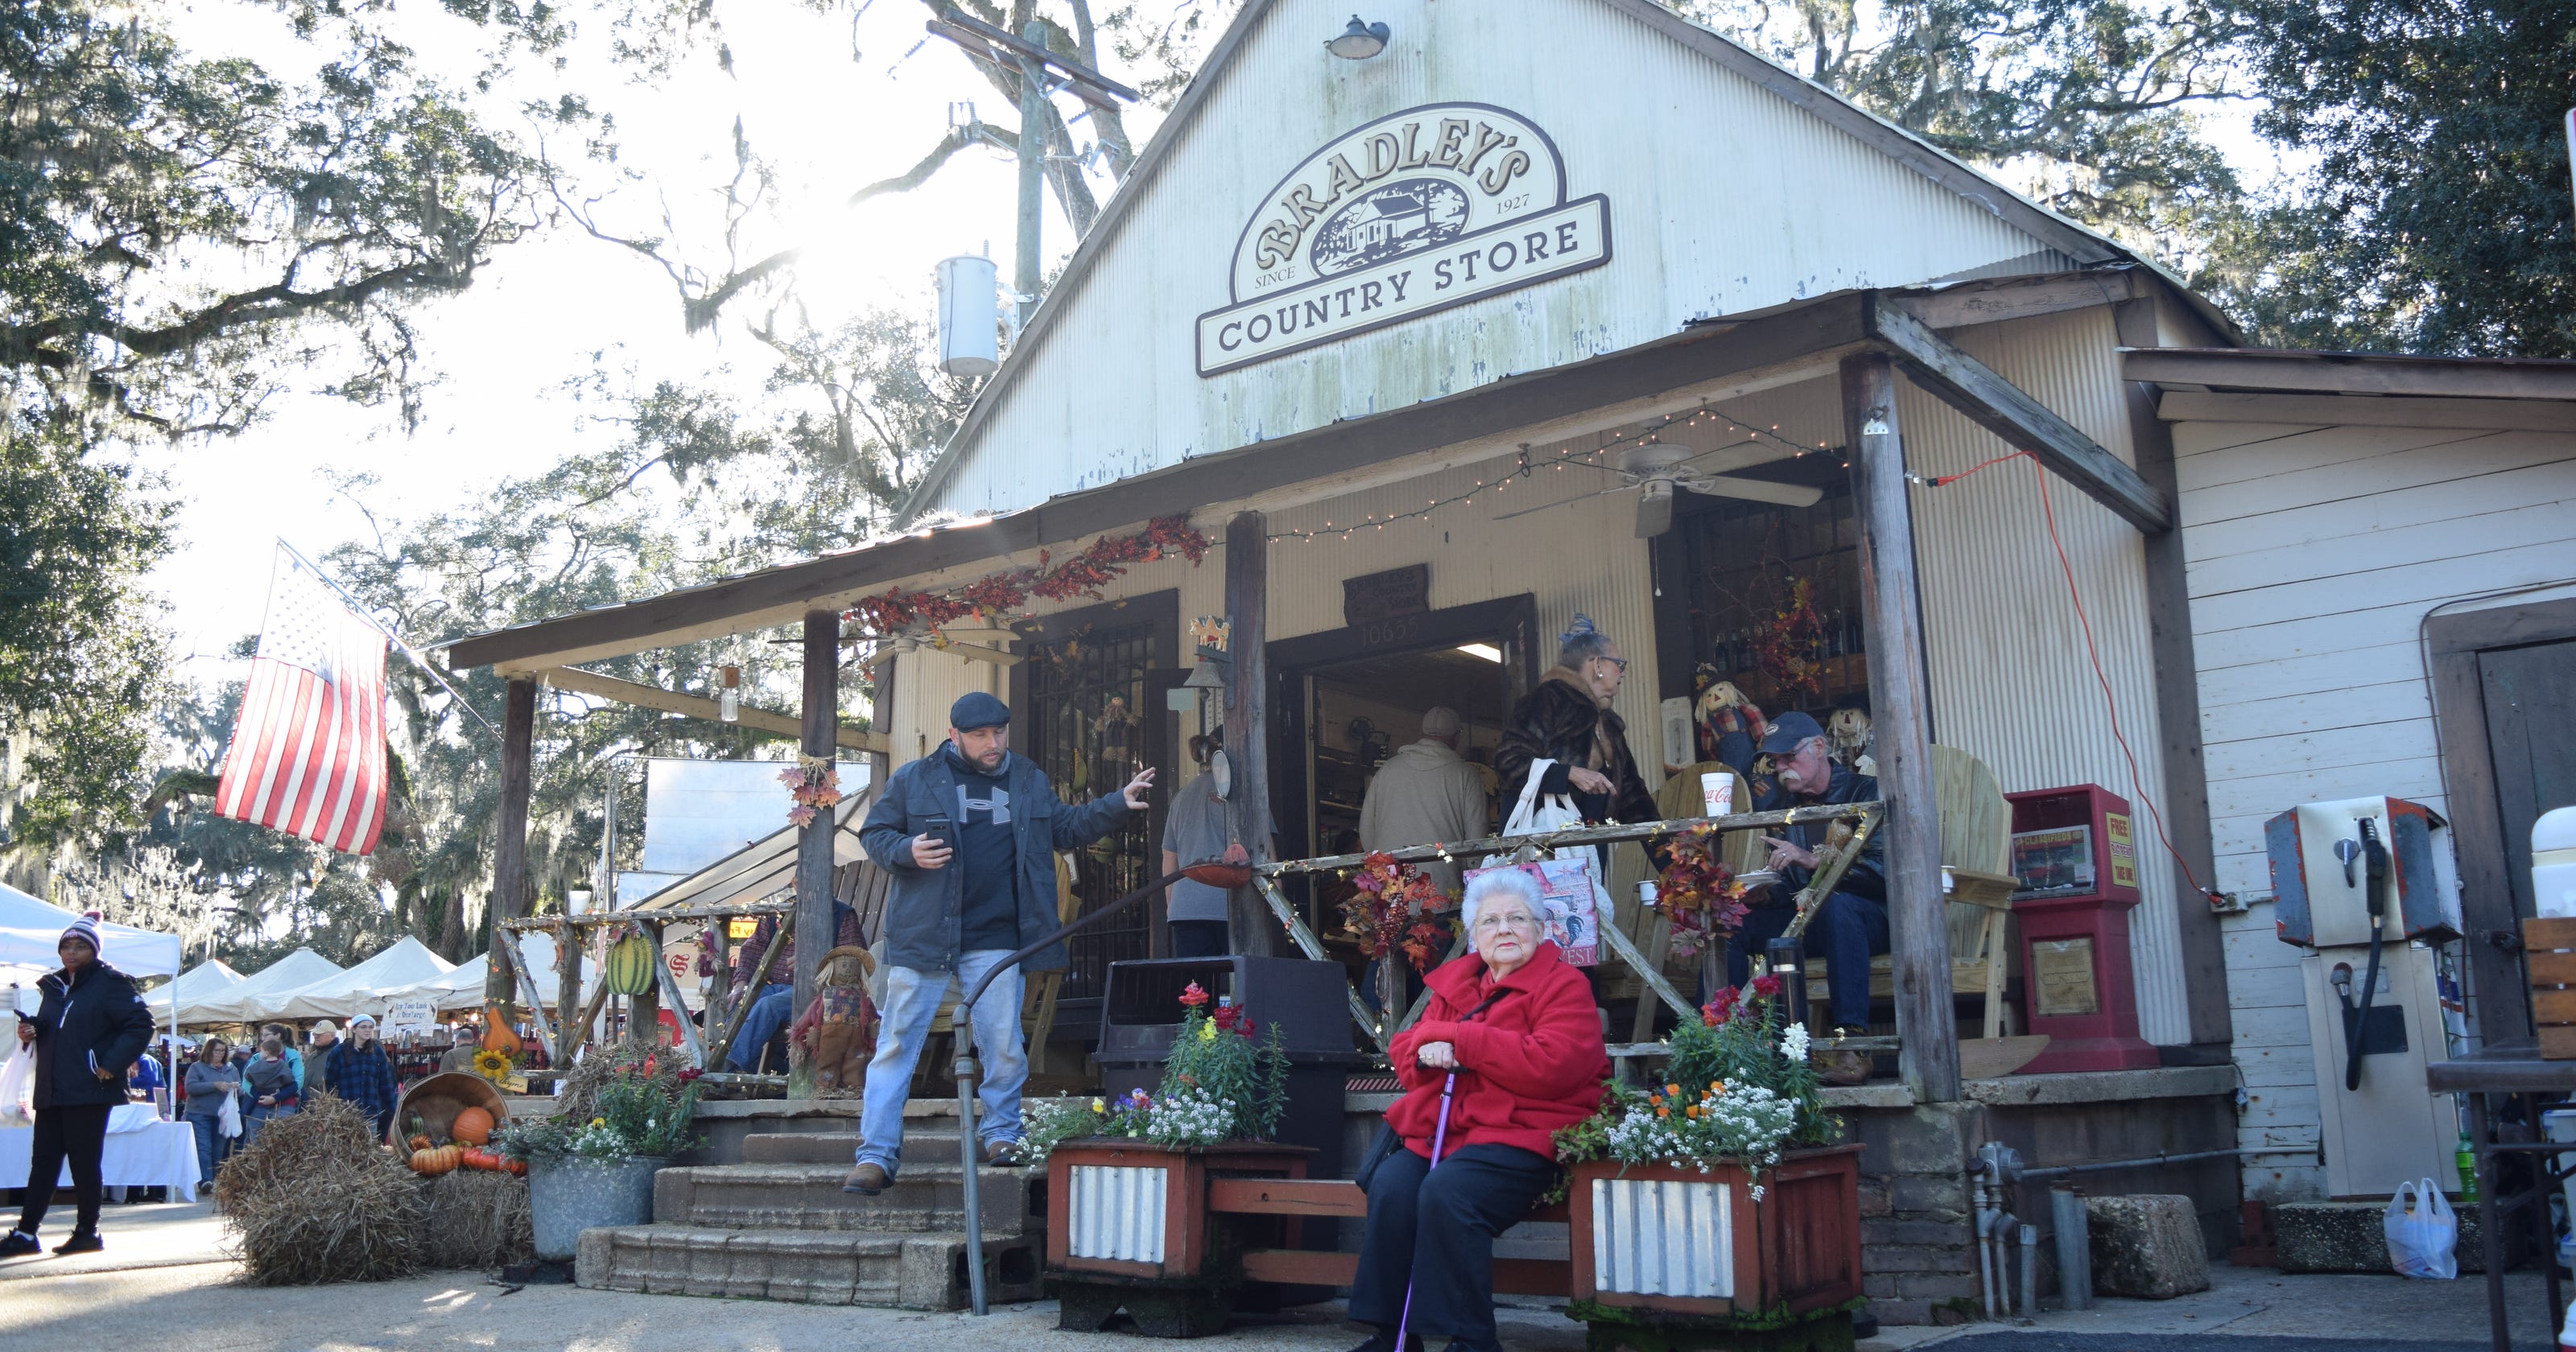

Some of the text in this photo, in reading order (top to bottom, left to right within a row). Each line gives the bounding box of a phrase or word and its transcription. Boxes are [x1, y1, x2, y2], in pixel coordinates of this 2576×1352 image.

[1256, 118, 1530, 270] BRADLEY'S
[1496, 193, 1530, 215] 1927
[1219, 221, 1578, 352] COUNTRY STORE
[1254, 266, 1295, 289] SINCE
[2025, 831, 2071, 844] CLASSIFIEDS
[2110, 818, 2128, 837] FREE
